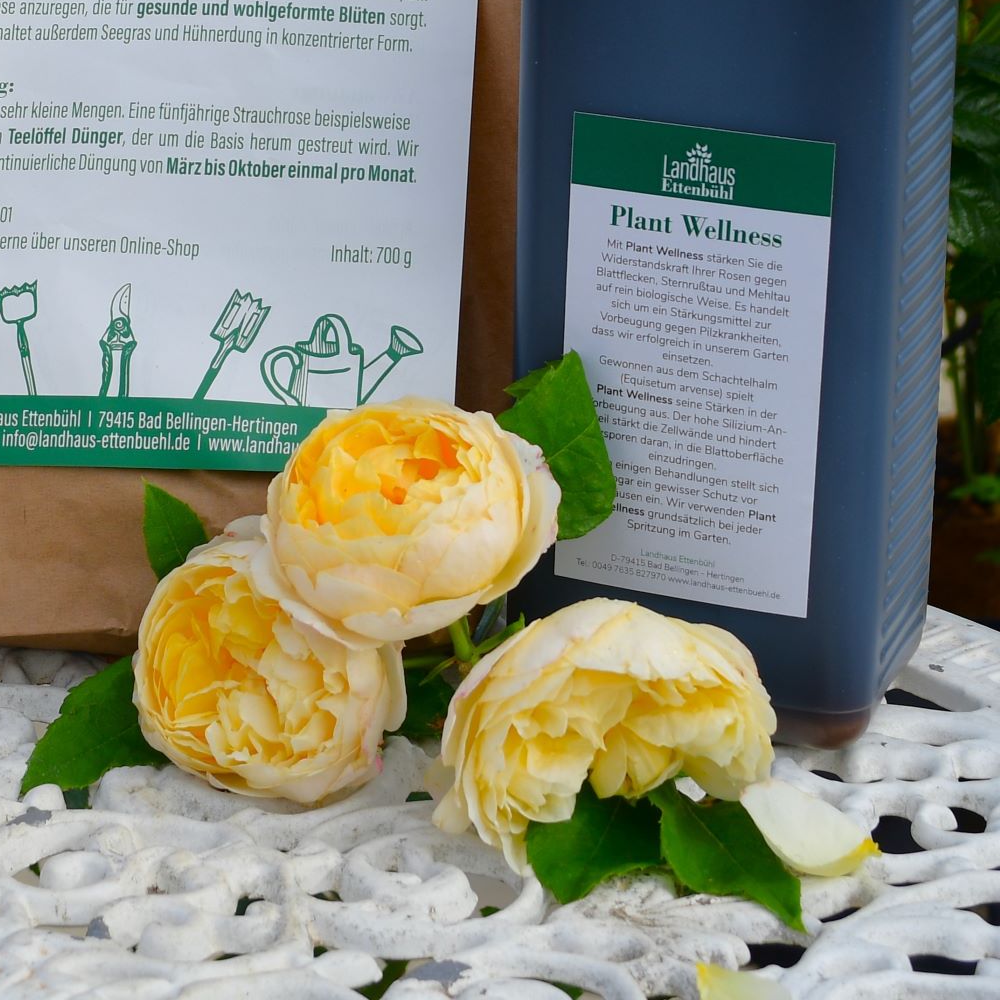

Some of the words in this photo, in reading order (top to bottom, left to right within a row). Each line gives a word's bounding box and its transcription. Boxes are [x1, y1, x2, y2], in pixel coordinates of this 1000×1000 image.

[19, 1, 87, 18] anzuregen,
[201, 0, 229, 16] und
[233, 1, 334, 22] wohlgeformte
[338, 5, 385, 24] Blüten
[389, 11, 426, 30] sorgt.
[9, 126, 66, 144] Teelöffel
[71, 127, 125, 148] Dünger,
[131, 128, 152, 145] der
[158, 132, 178, 147] um
[184, 129, 204, 148] die
[210, 131, 244, 149] Basis
[249, 132, 291, 151] herum
[297, 136, 352, 155] gestreut
[358, 137, 390, 155] wird.
[397, 139, 419, 156] Wir
[78, 153, 136, 176] Düngung
[139, 159, 163, 173] von
[165, 156, 202, 175] März
[203, 157, 225, 176] bis
[228, 158, 286, 178] Oktober
[287, 160, 338, 179] einmal
[340, 166, 365, 184] pro
[367, 164, 416, 183] Monat.
[663, 154, 735, 185] Landhaus
[661, 178, 734, 200] Ettenbühl
[610, 205, 672, 234] Plant
[681, 215, 782, 248] Wellness
[30, 232, 59, 249] über
[63, 236, 116, 253] unseren
[119, 235, 199, 260] Online-Shop
[330, 244, 372, 263] Inhalt:
[376, 246, 400, 264] 700
[403, 250, 411, 268] g
[607, 237, 623, 249] Mit
[625, 240, 653, 254] Plant
[656, 244, 703, 261] Wellness
[706, 253, 744, 266] stärken
[747, 257, 763, 268] Sie
[766, 260, 782, 271] die
[599, 251, 689, 274] Widerstandskraft
[691, 264, 715, 277] Ihrer
[718, 268, 751, 282] Rosen
[753, 275, 786, 287] gegen
[660, 275, 722, 293] Sternrußtau
[725, 286, 745, 296] und
[747, 287, 790, 302] Mehltau
[1, 428, 190, 450] info@landhaus-ettenbuehl.de
[21, 409, 81, 429] Ettenbühl
[98, 410, 134, 431] 79415
[137, 412, 162, 432] Bad
[165, 412, 297, 439] Bellingen-Hertingen
